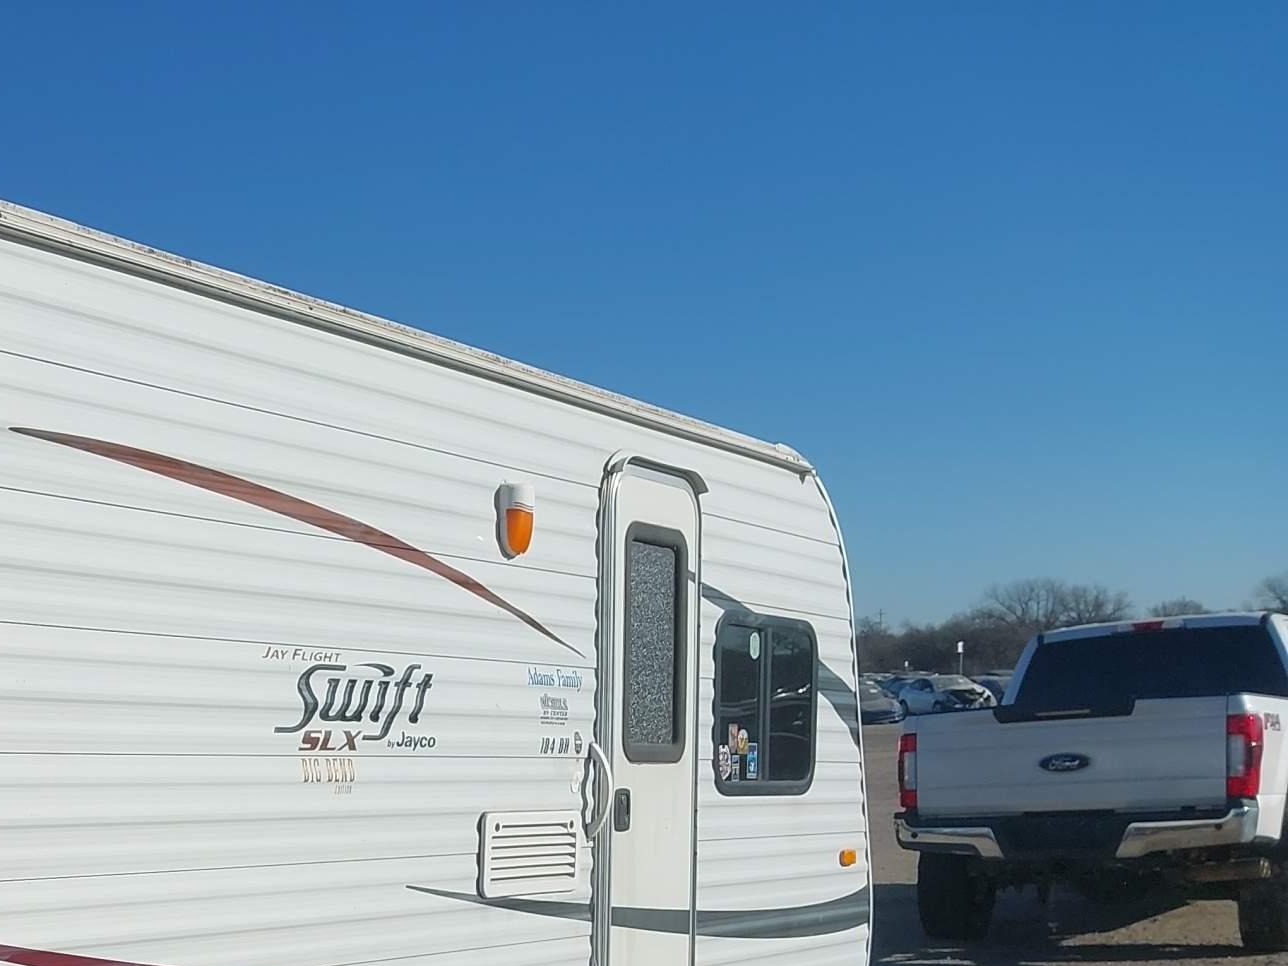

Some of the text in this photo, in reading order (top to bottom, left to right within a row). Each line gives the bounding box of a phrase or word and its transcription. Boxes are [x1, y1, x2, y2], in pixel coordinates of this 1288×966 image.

[262, 646, 342, 663] JAY FLIGHT
[528, 666, 583, 692] Adams Family
[274, 663, 433, 740] Swift
[298, 730, 436, 751] SLX by Jayco
[540, 737, 555, 754] 184
[301, 758, 355, 783] BIG BEND
